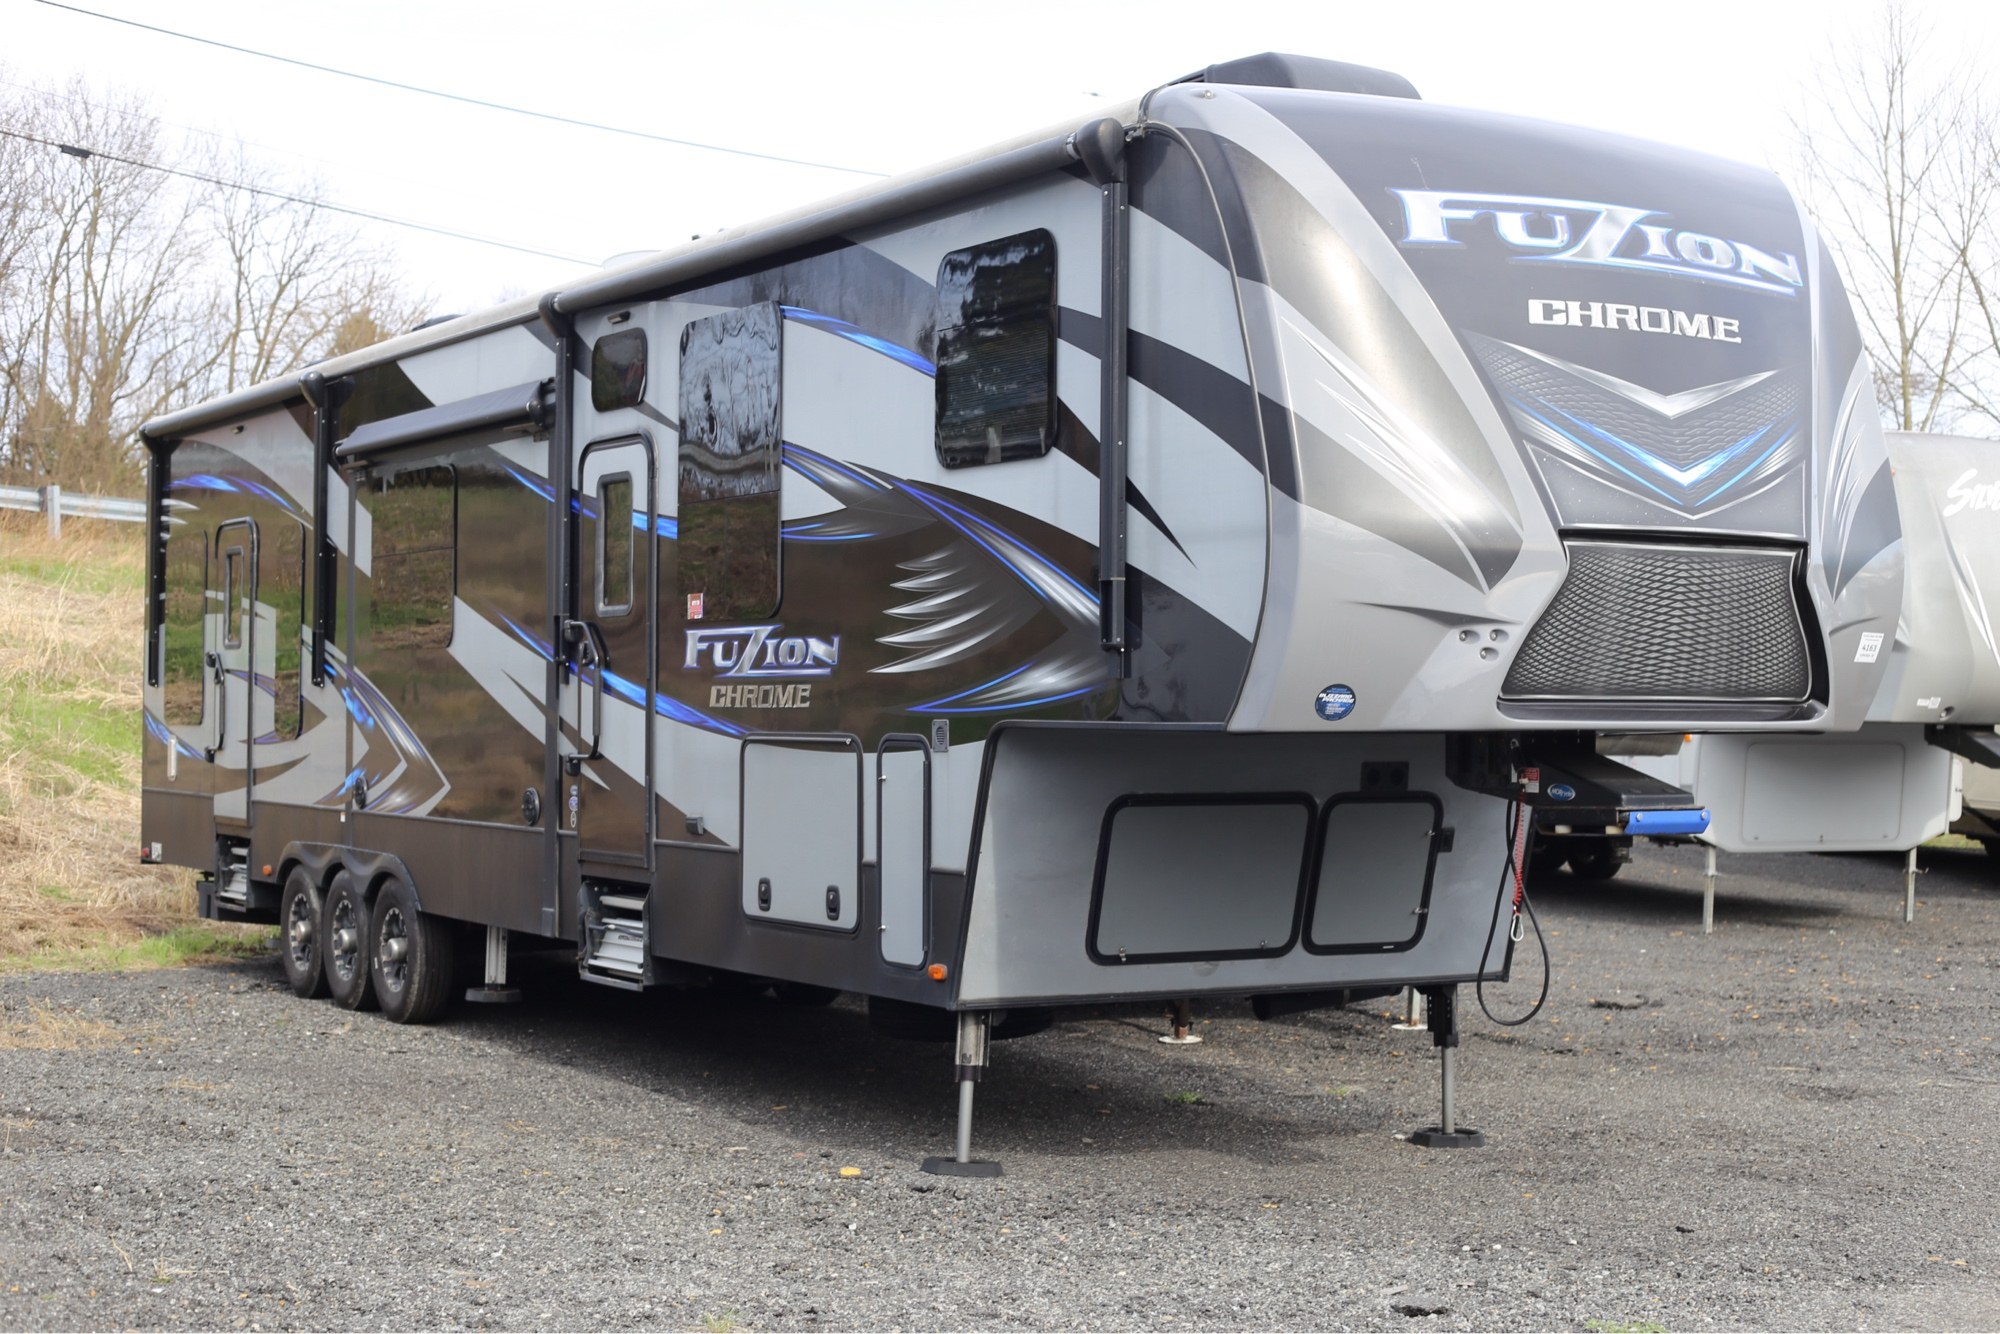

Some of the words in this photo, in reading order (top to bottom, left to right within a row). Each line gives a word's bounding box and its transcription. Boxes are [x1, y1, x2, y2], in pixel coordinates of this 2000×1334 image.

[1387, 186, 1803, 297] FUZION
[1527, 298, 1742, 344] CHROME
[683, 623, 841, 678] FUZION
[708, 684, 812, 709] CHROME
